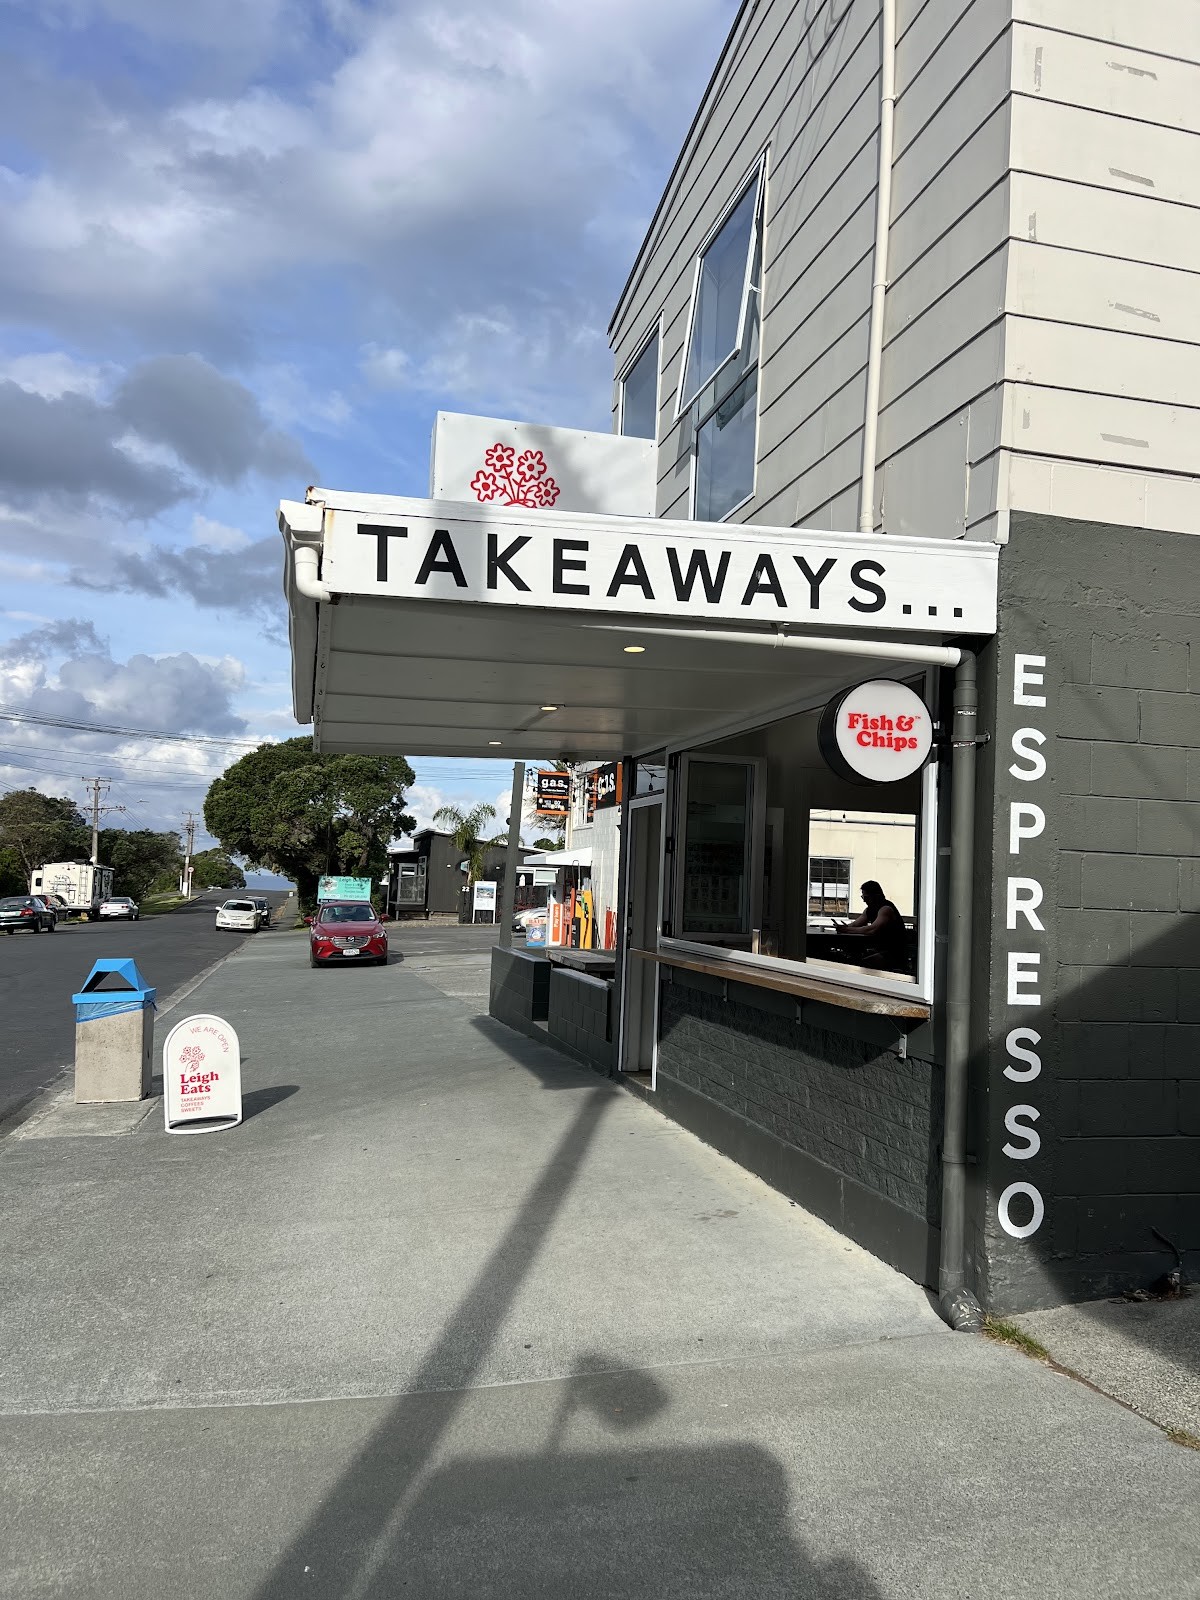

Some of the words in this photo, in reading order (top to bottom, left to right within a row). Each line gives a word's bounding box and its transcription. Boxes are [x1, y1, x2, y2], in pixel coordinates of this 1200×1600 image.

[856, 731, 918, 752] Chips
[998, 653, 1048, 1240] ESPRESSO
[190, 1026, 202, 1034] WE
[203, 1026, 219, 1036] ARE
[217, 1034, 229, 1053] OPEN
[180, 1071, 219, 1084] Leigh
[180, 1084, 211, 1094] Eats
